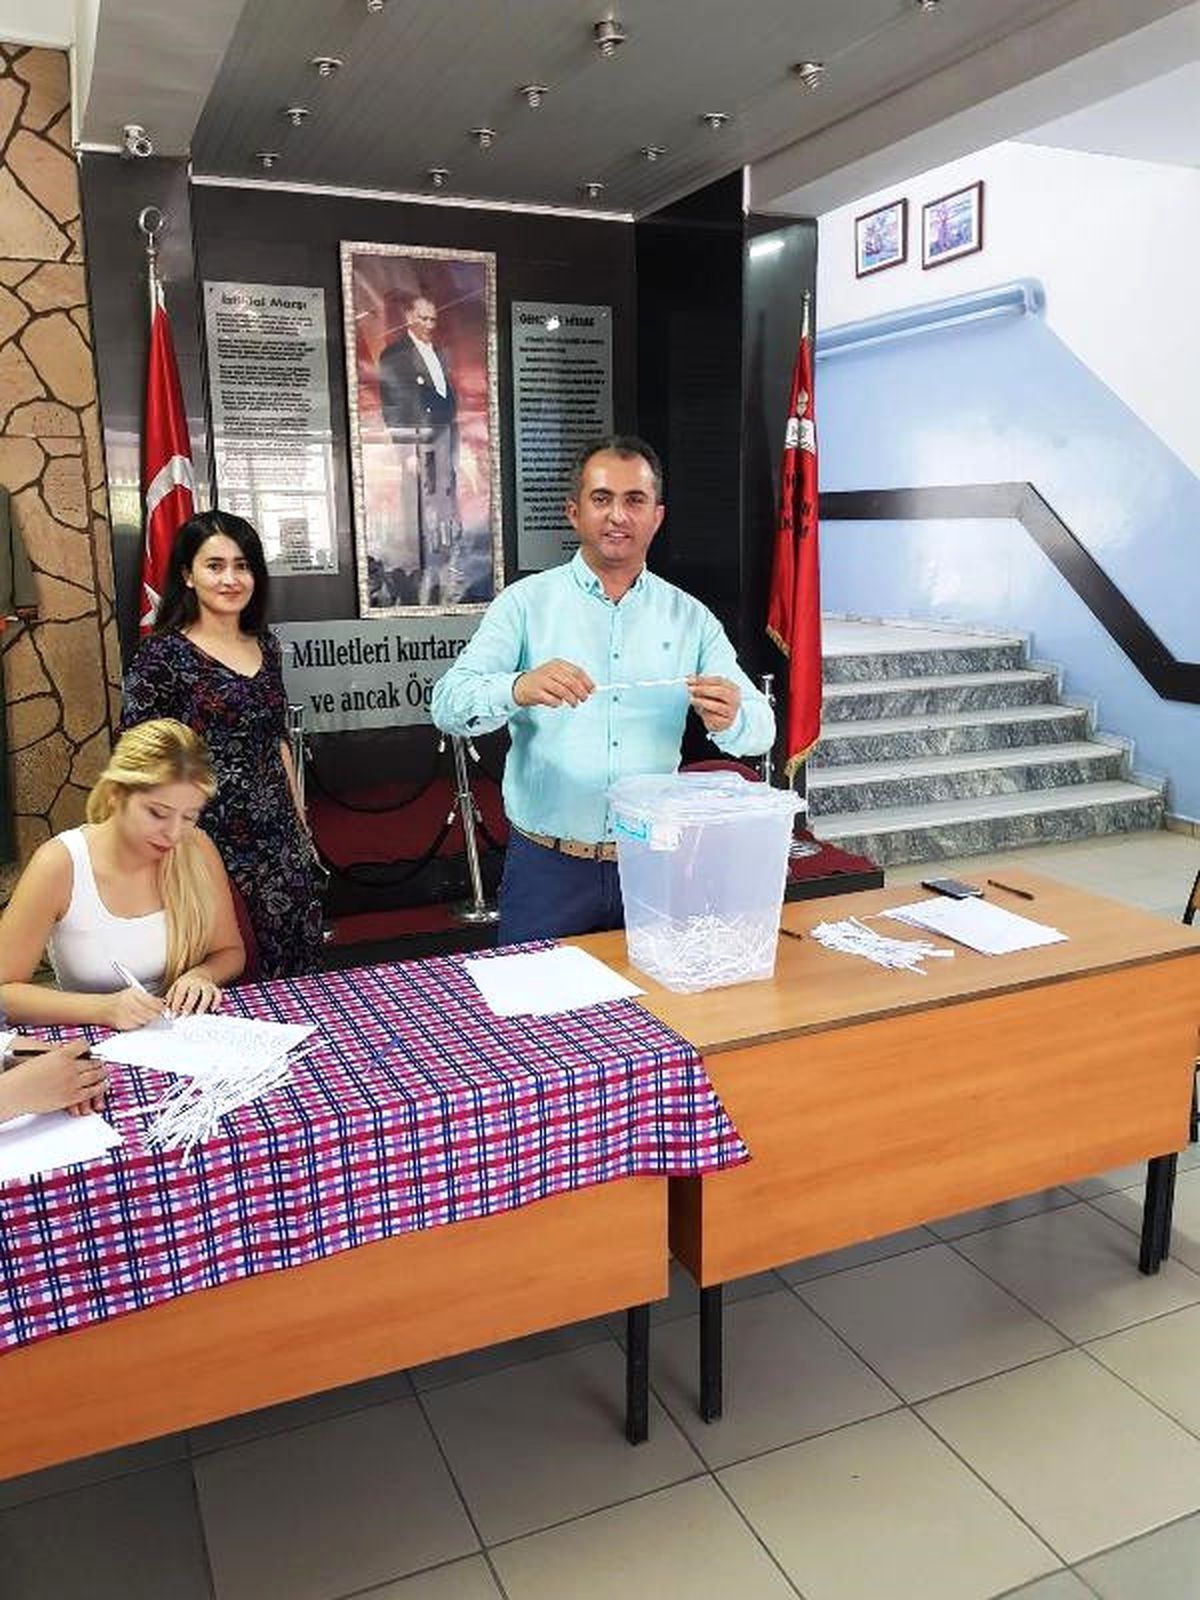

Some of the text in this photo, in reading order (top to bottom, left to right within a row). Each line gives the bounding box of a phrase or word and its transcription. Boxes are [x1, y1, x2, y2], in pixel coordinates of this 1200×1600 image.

[292, 634, 472, 669] Milletleri kurtara
[311, 693, 335, 713] ve
[341, 682, 400, 712] ancak
